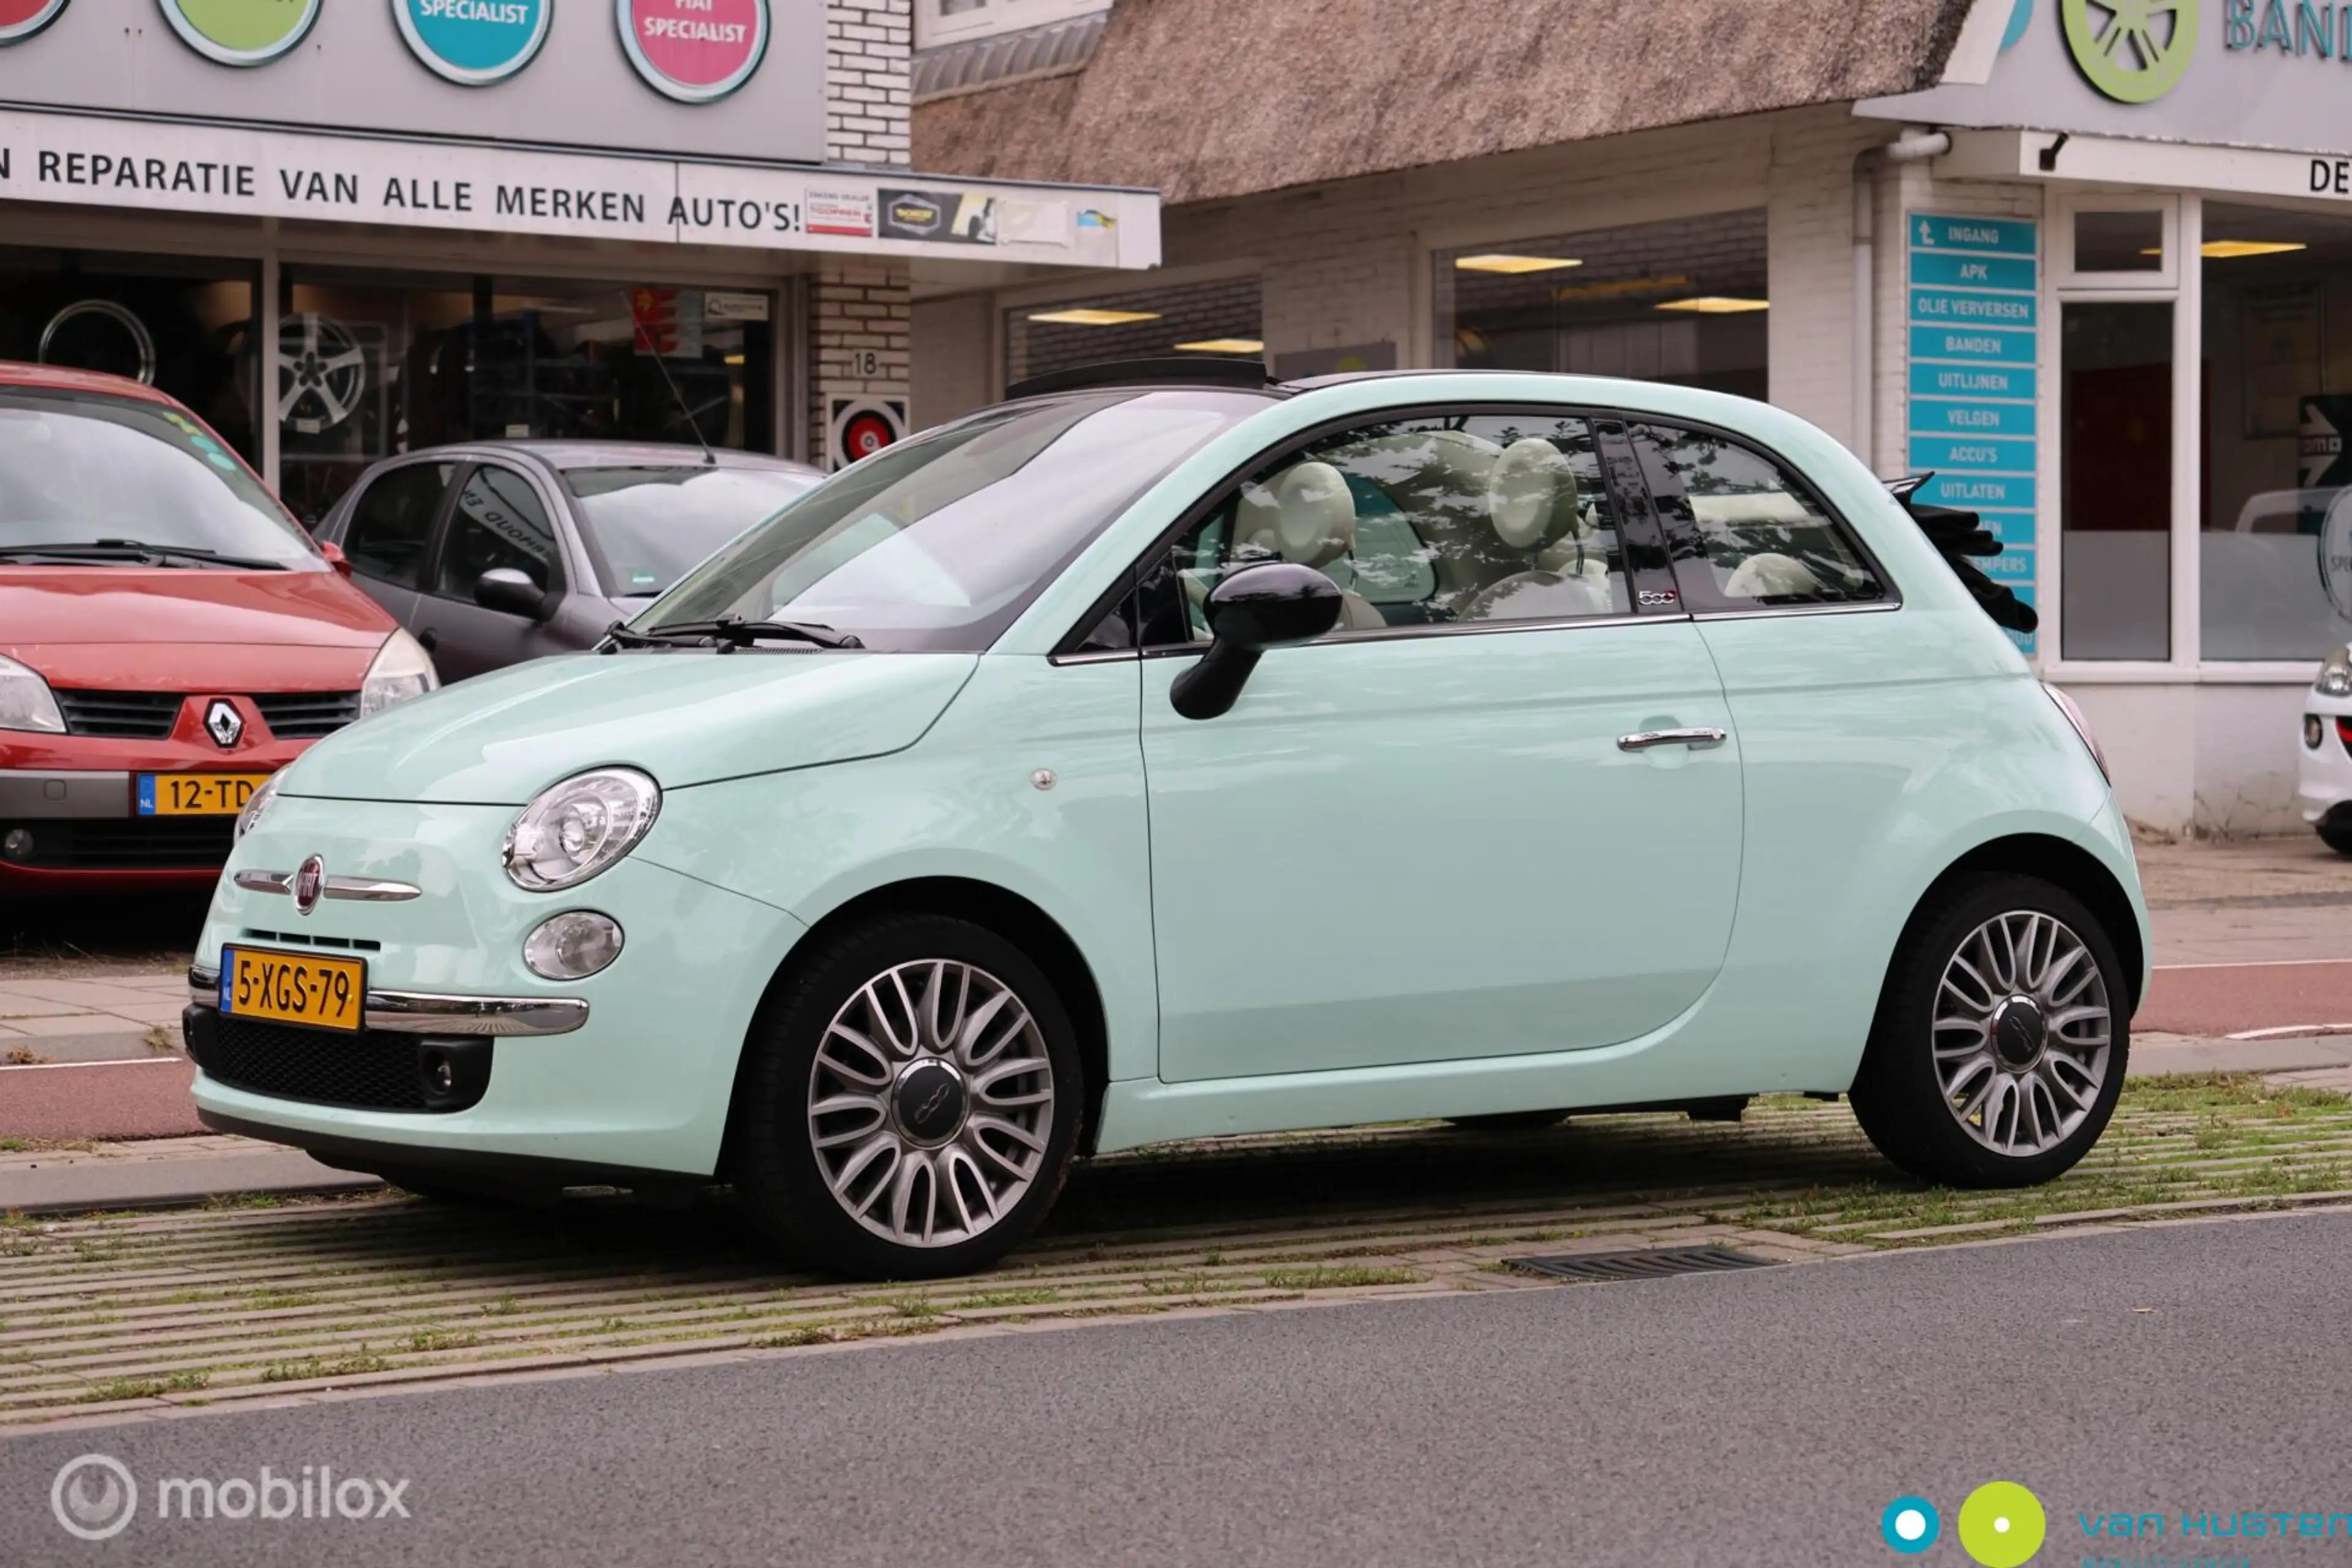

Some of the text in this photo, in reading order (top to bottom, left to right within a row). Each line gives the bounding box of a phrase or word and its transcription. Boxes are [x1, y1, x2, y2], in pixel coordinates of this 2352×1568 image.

[420, 0, 529, 24] SPECIALIST
[643, 17, 747, 43] SPECIALIST
[2310, 160, 2350, 194] DE
[39, 150, 255, 197] REPARATIE
[281, 169, 358, 203] VAN
[383, 178, 472, 211] ALLE
[497, 185, 644, 223] MERKEN
[668, 197, 801, 232] AUTO'S!
[1948, 226, 1999, 244] INGANG
[1960, 263, 1988, 279] APK
[1918, 296, 2029, 318] OLIE VERVERSEN
[1945, 336, 2002, 353] BANDEN
[855, 352, 876, 375] 18
[1939, 372, 2008, 390] UITLIJNEN
[1947, 409, 2000, 427] VELGEN
[1949, 446, 1997, 463] ACCU'S
[1940, 481, 2005, 499] UITLATEN
[140, 780, 254, 809] NL 12-TD
[239, 960, 349, 1017] 5-XGS-79
